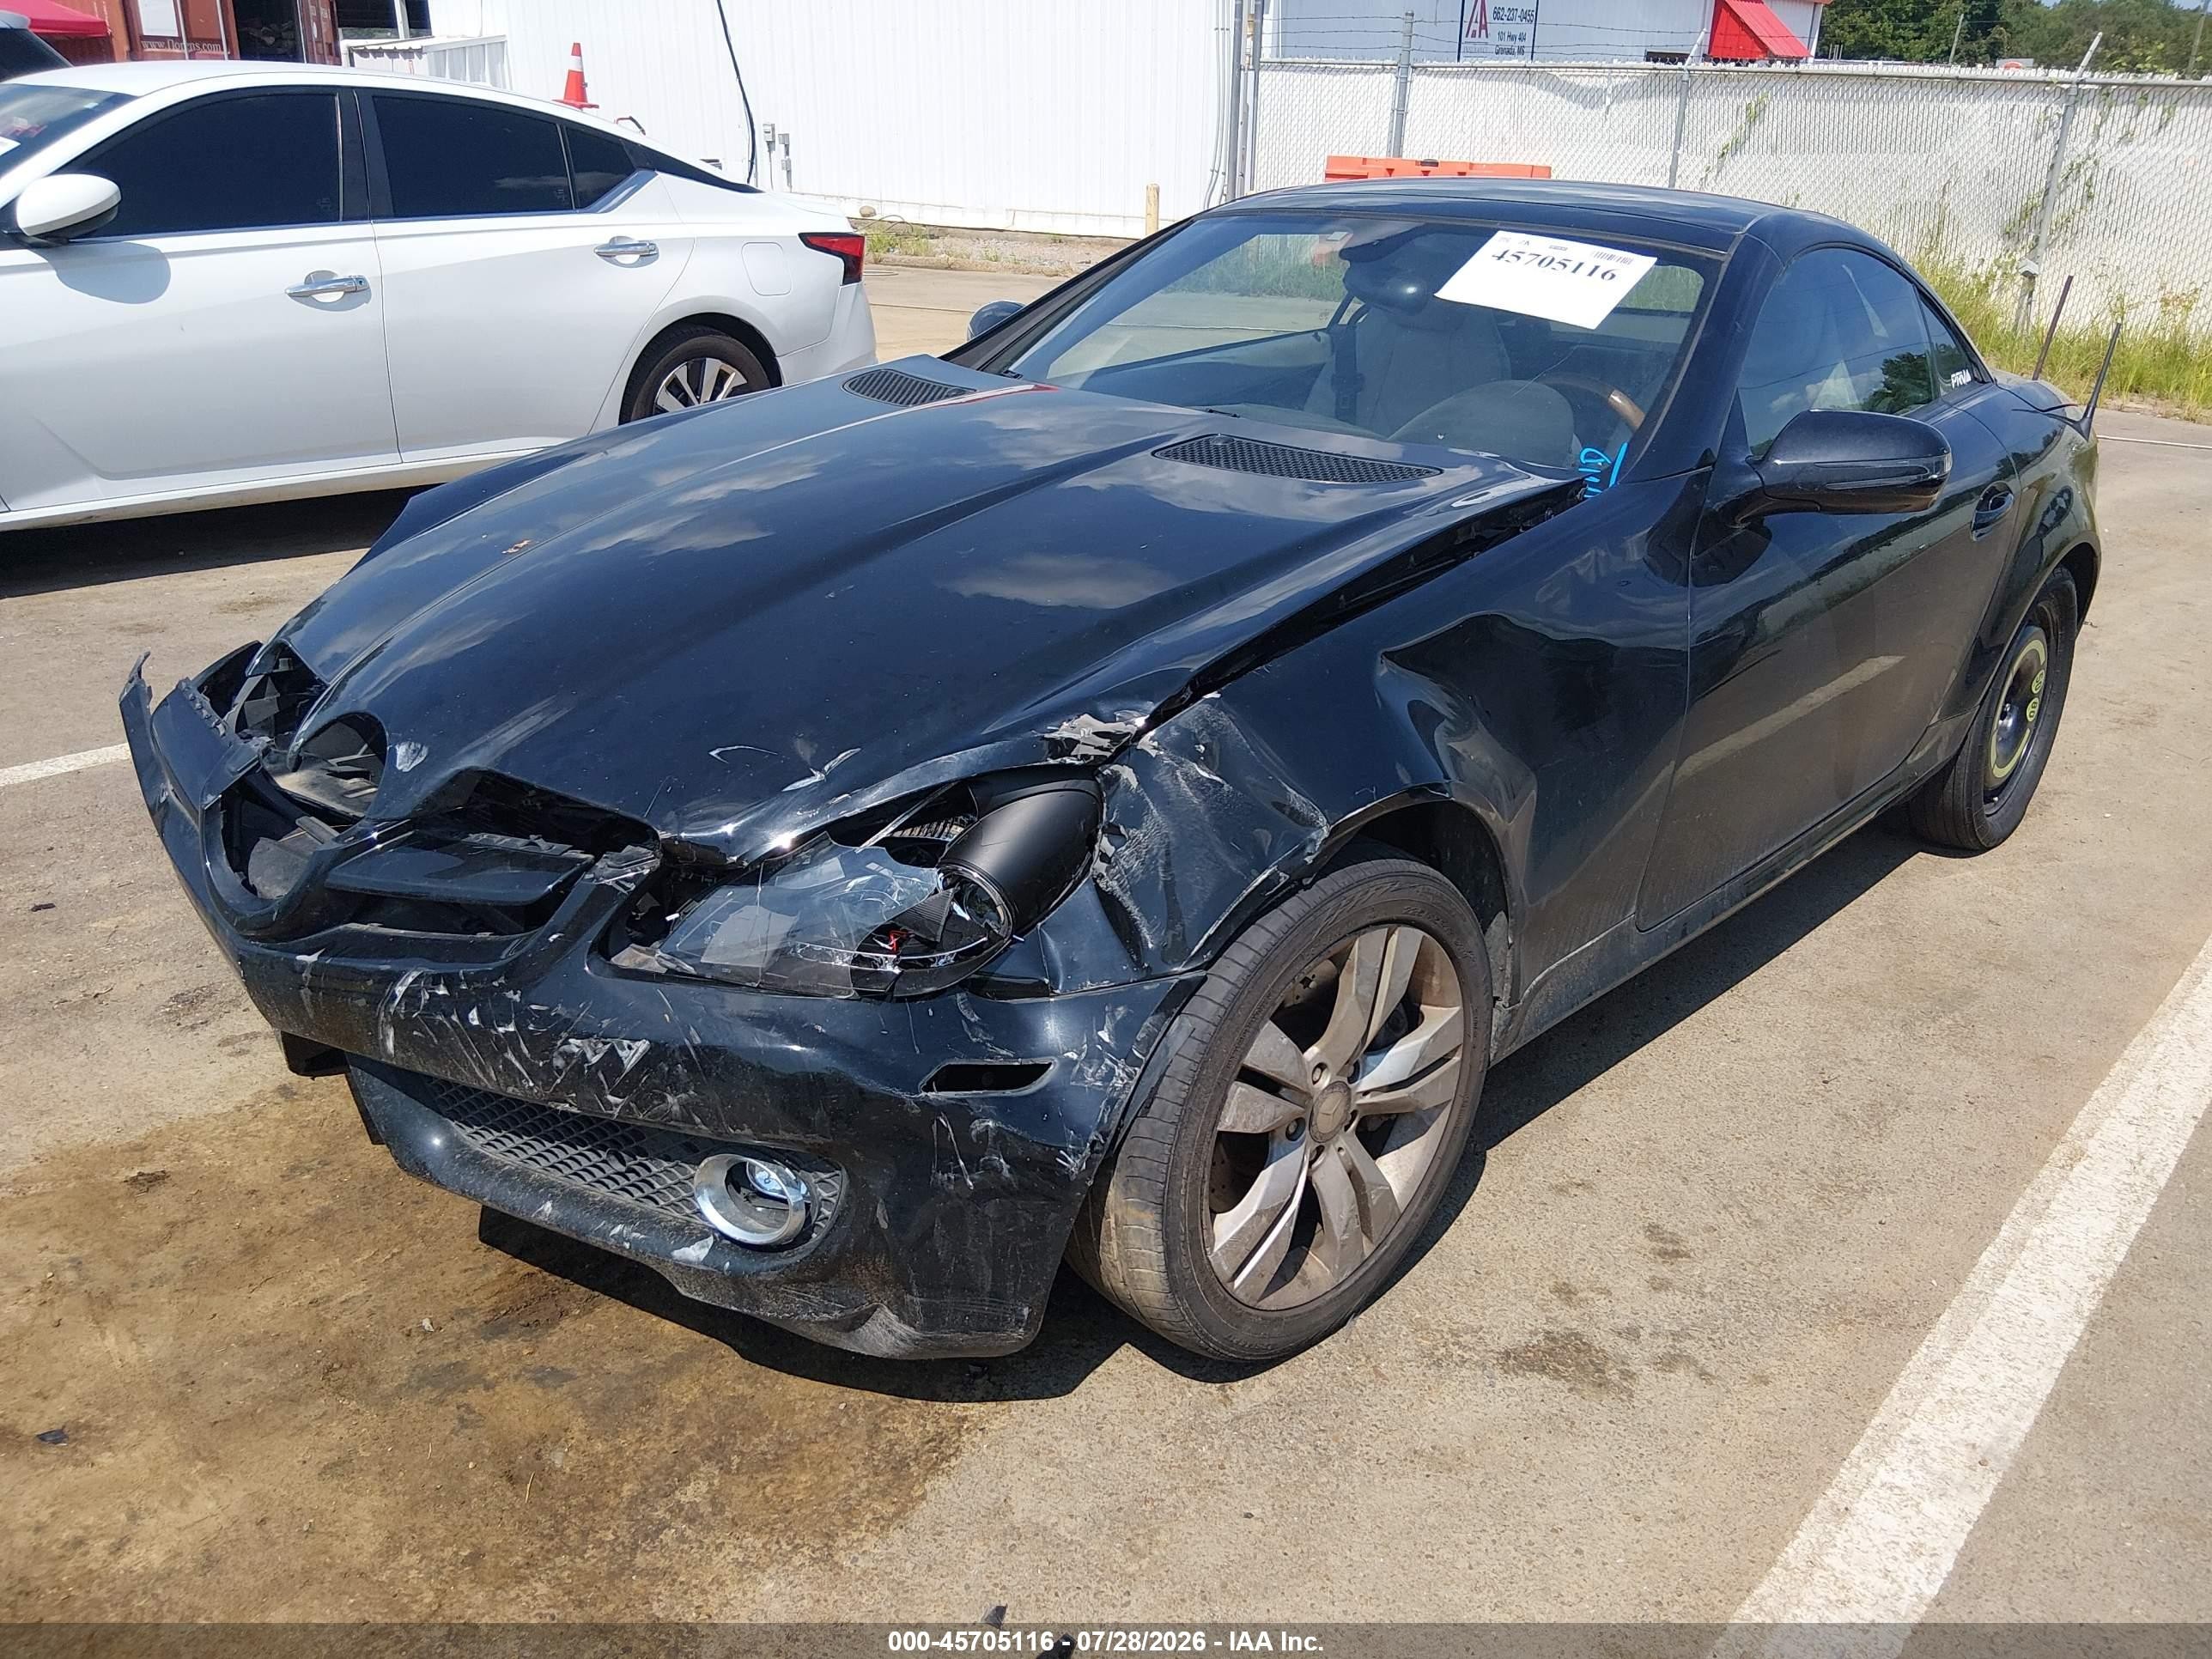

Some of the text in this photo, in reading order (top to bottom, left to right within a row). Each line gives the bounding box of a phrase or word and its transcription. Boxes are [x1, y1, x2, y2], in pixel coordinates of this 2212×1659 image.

[1492, 6, 1534, 23] 662-237-0455
[1498, 32, 1506, 42] 101
[1507, 32, 1517, 45] Hwy
[1495, 45, 1516, 57] Grenada,
[1516, 45, 1525, 56] MS
[1492, 248, 1617, 281] 45705116
